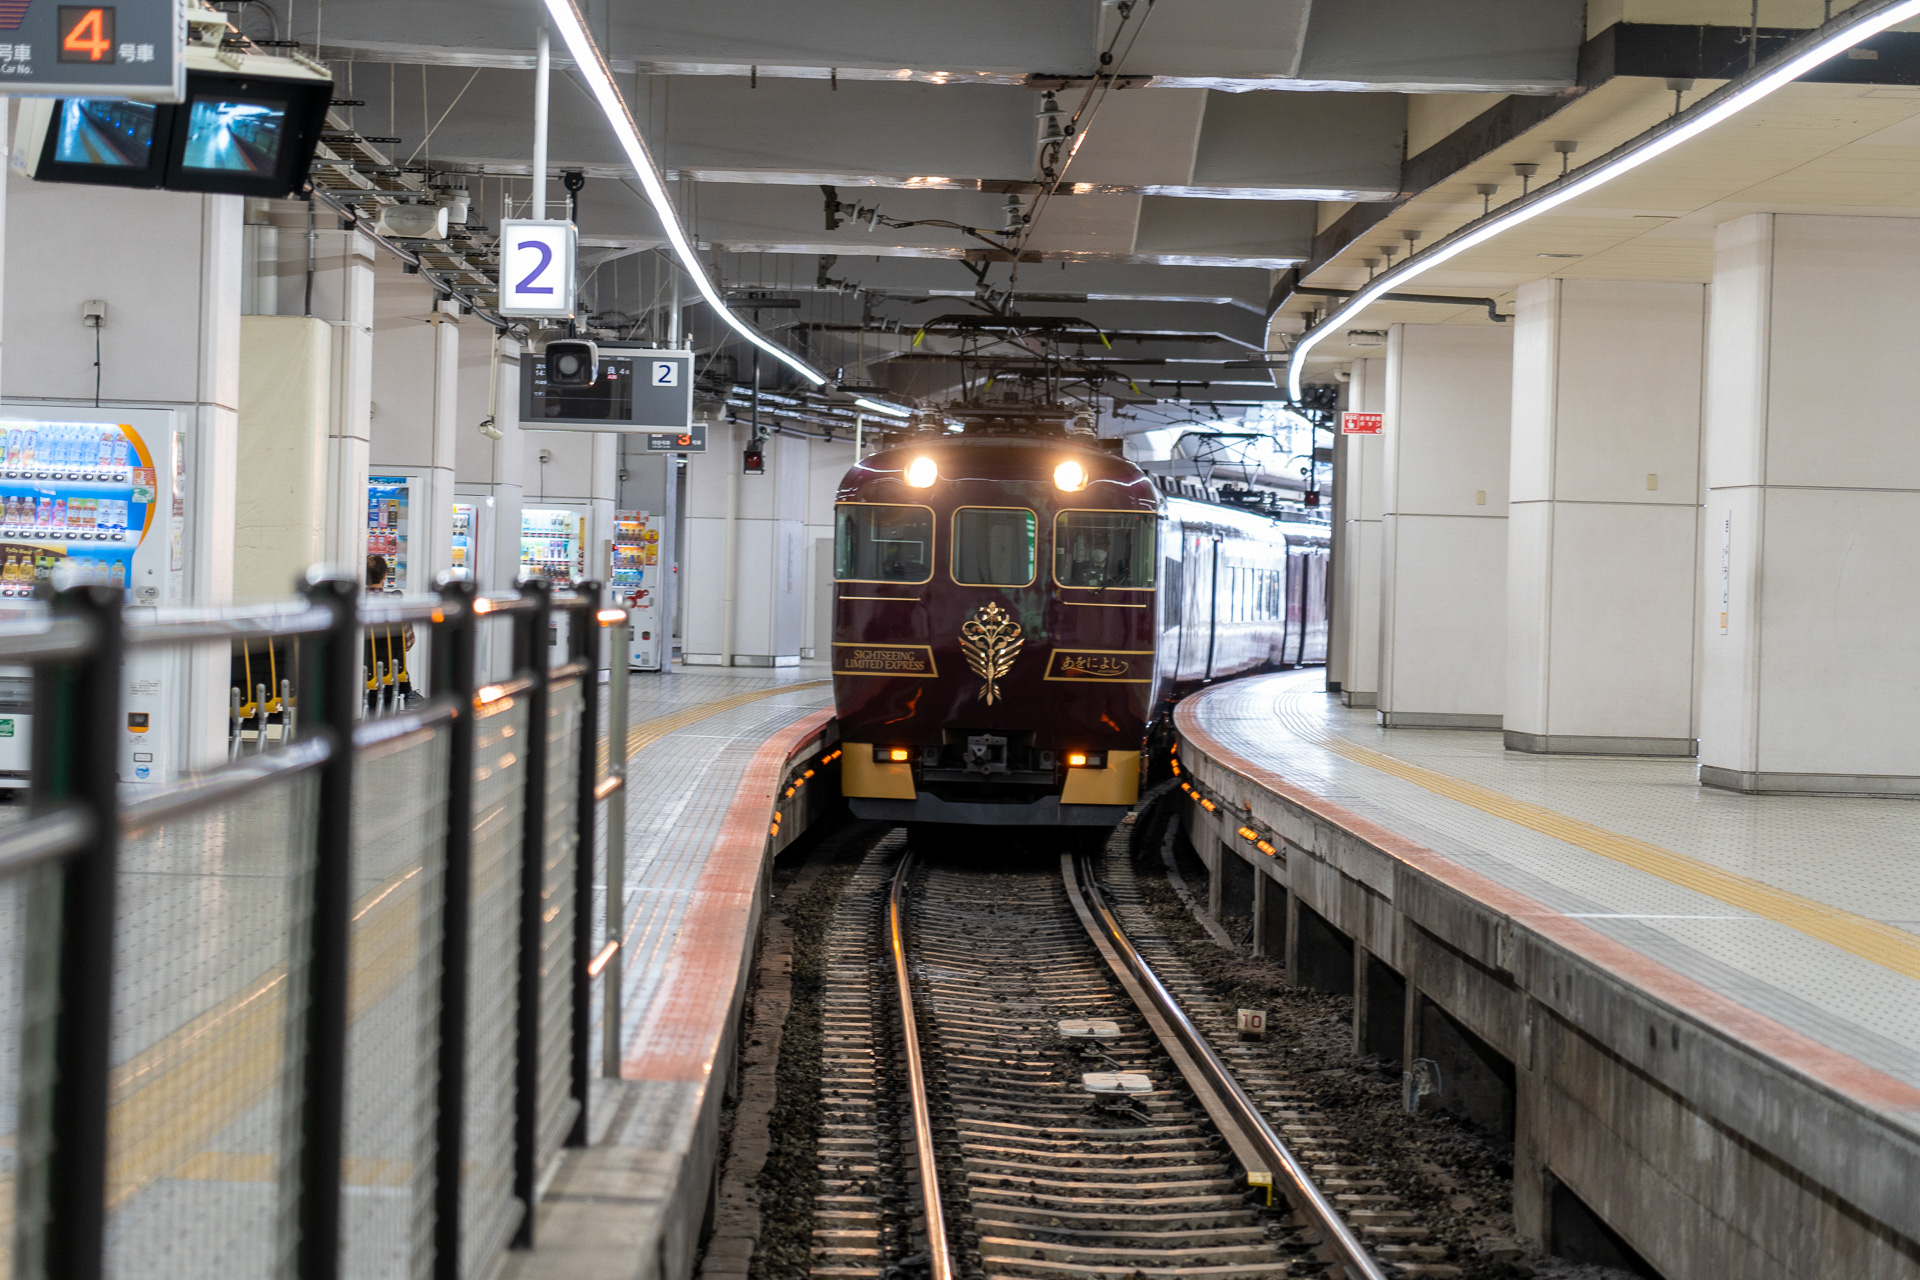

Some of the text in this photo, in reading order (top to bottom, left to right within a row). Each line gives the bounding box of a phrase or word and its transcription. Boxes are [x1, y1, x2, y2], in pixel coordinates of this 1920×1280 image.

[64, 8, 155, 63] 4 号車
[515, 240, 554, 294] 2
[658, 364, 673, 383] 2
[677, 434, 690, 446] 3
[853, 650, 915, 661] SIGHTSEEING
[845, 659, 925, 671] LIMITED EXPRESS
[1061, 656, 1126, 674] あをによし
[1242, 1014, 1262, 1028] 10
